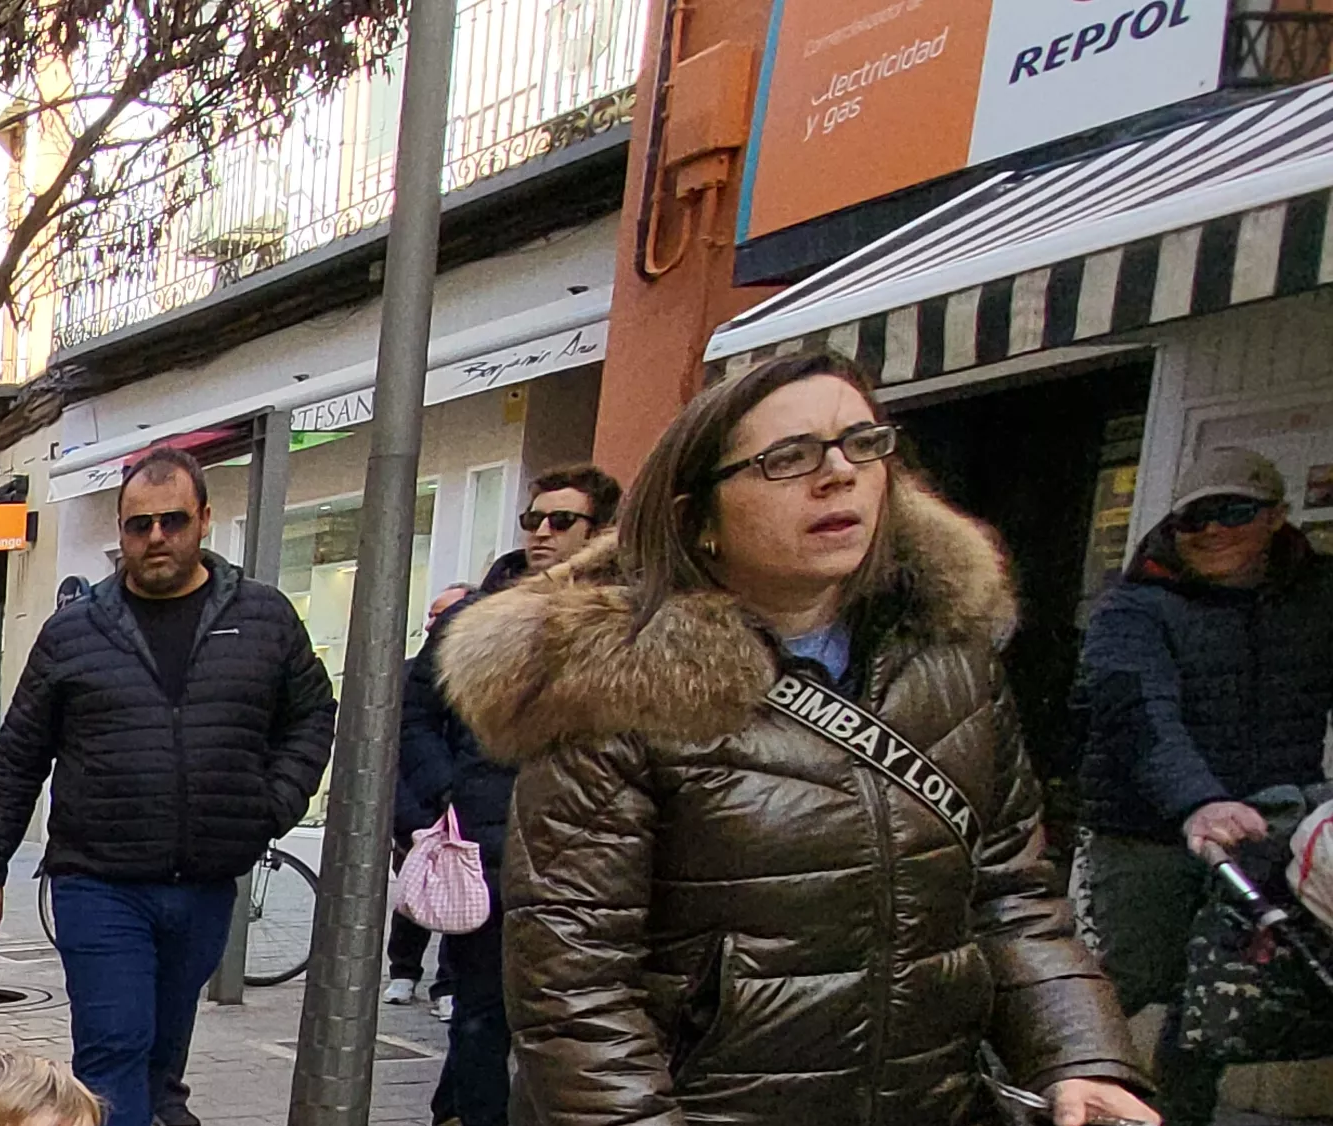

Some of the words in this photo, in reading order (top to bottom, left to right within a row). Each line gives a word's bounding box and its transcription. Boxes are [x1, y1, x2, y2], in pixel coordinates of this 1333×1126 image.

[1009, 0, 1190, 84] REPSOL
[803, 113, 819, 142] y
[822, 96, 862, 134] gas
[290, 395, 373, 430] TESAN
[767, 675, 881, 757] BIMBA
[903, 759, 973, 836] LOLA
